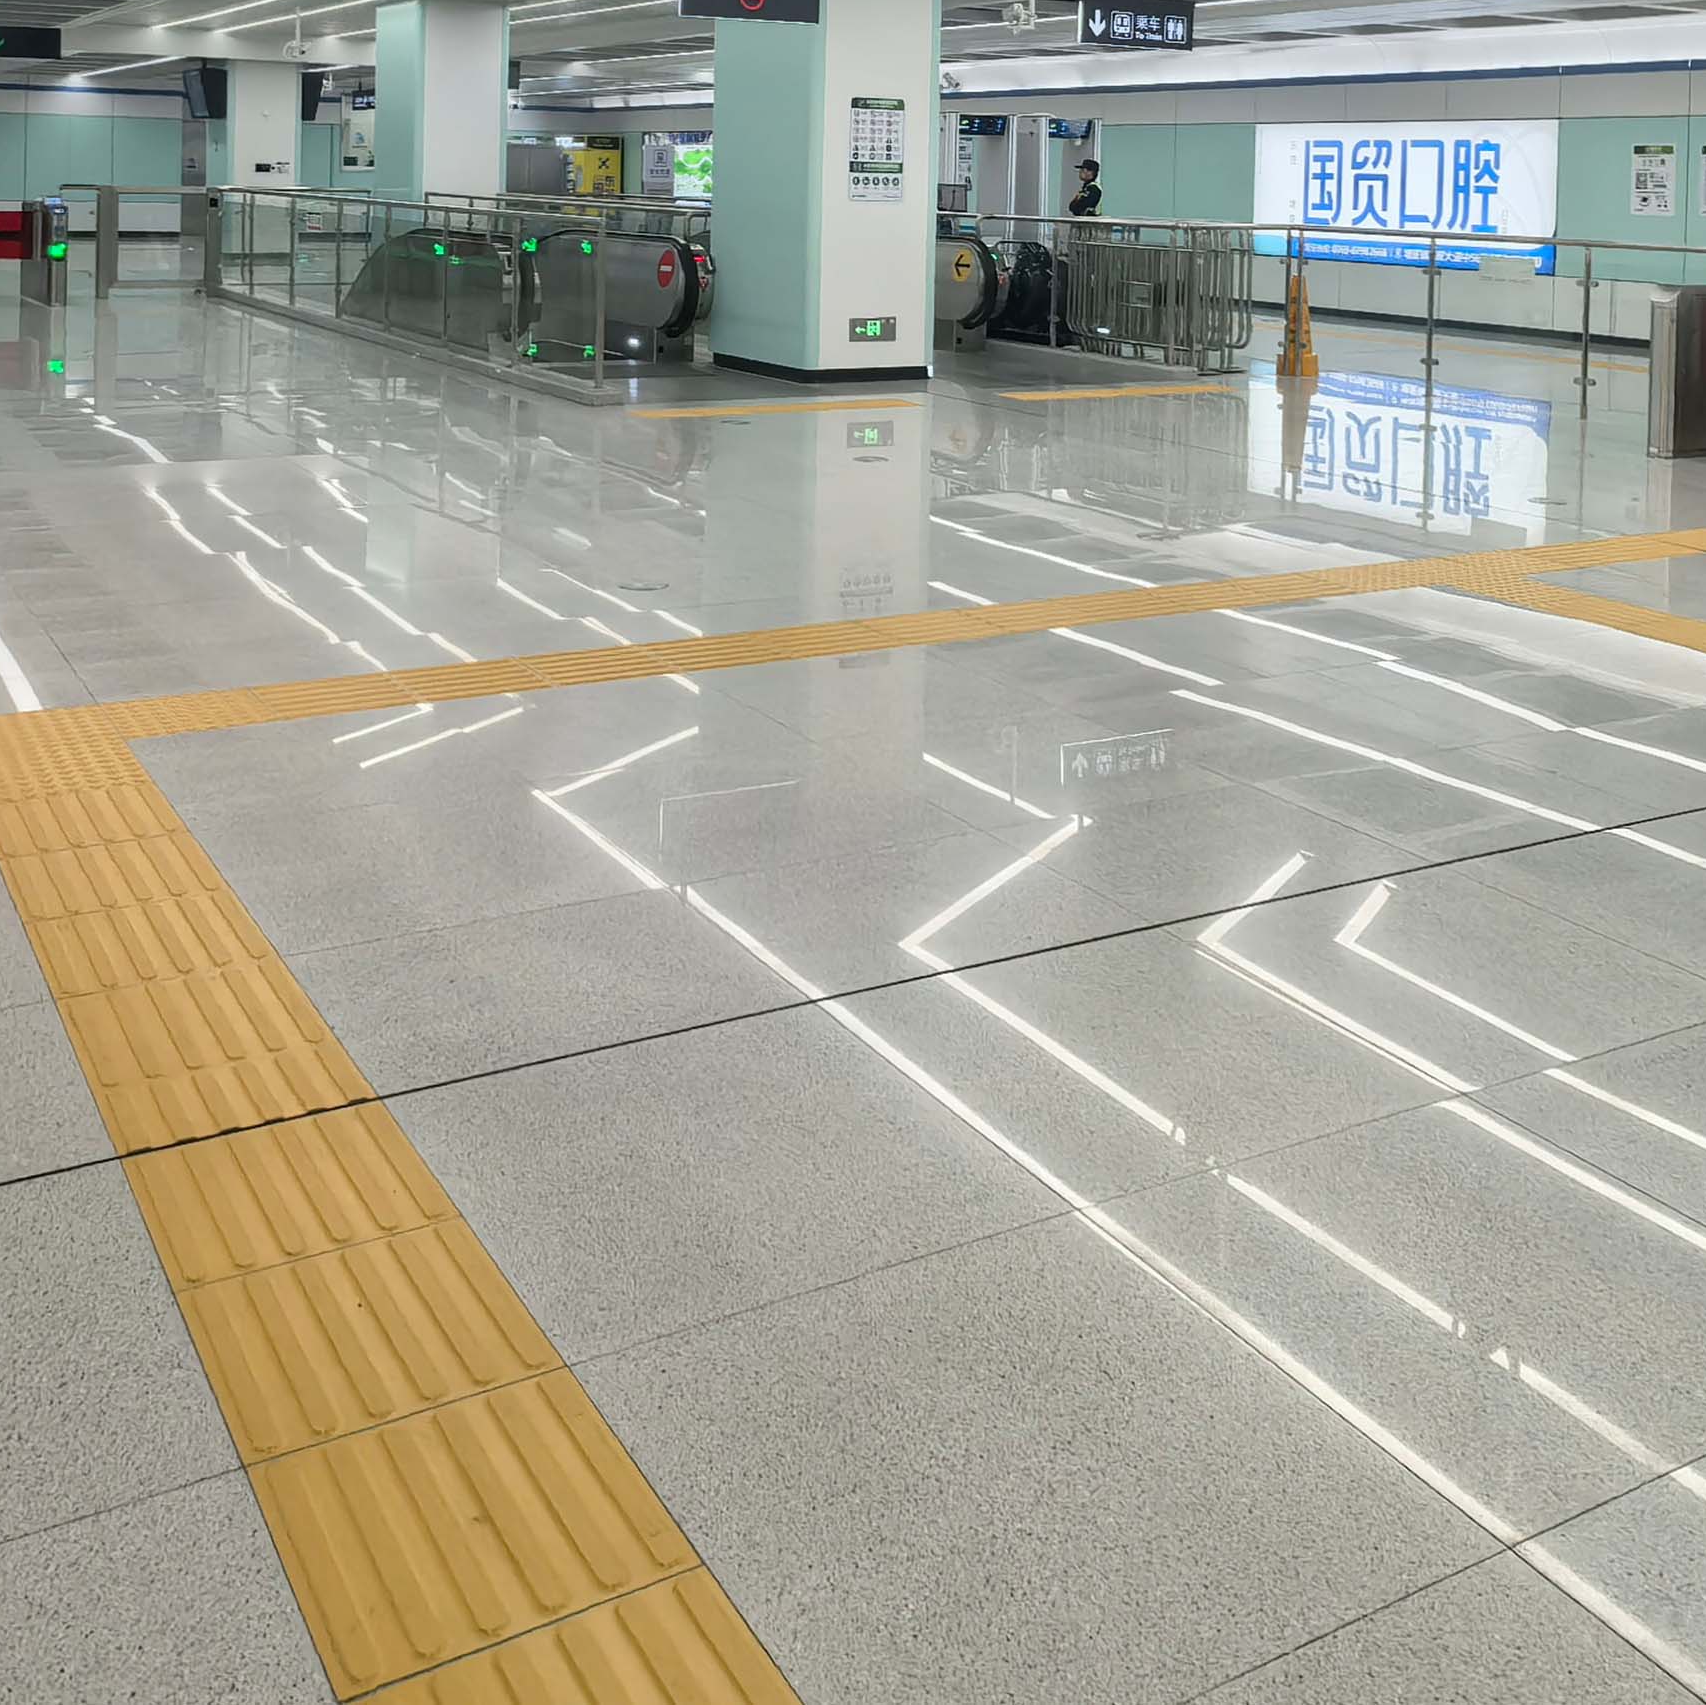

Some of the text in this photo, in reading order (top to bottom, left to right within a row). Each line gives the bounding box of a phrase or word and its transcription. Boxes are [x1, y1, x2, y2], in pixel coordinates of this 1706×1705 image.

[1135, 15, 1161, 31] 乘车
[1303, 139, 1501, 234] 国贸口腔
